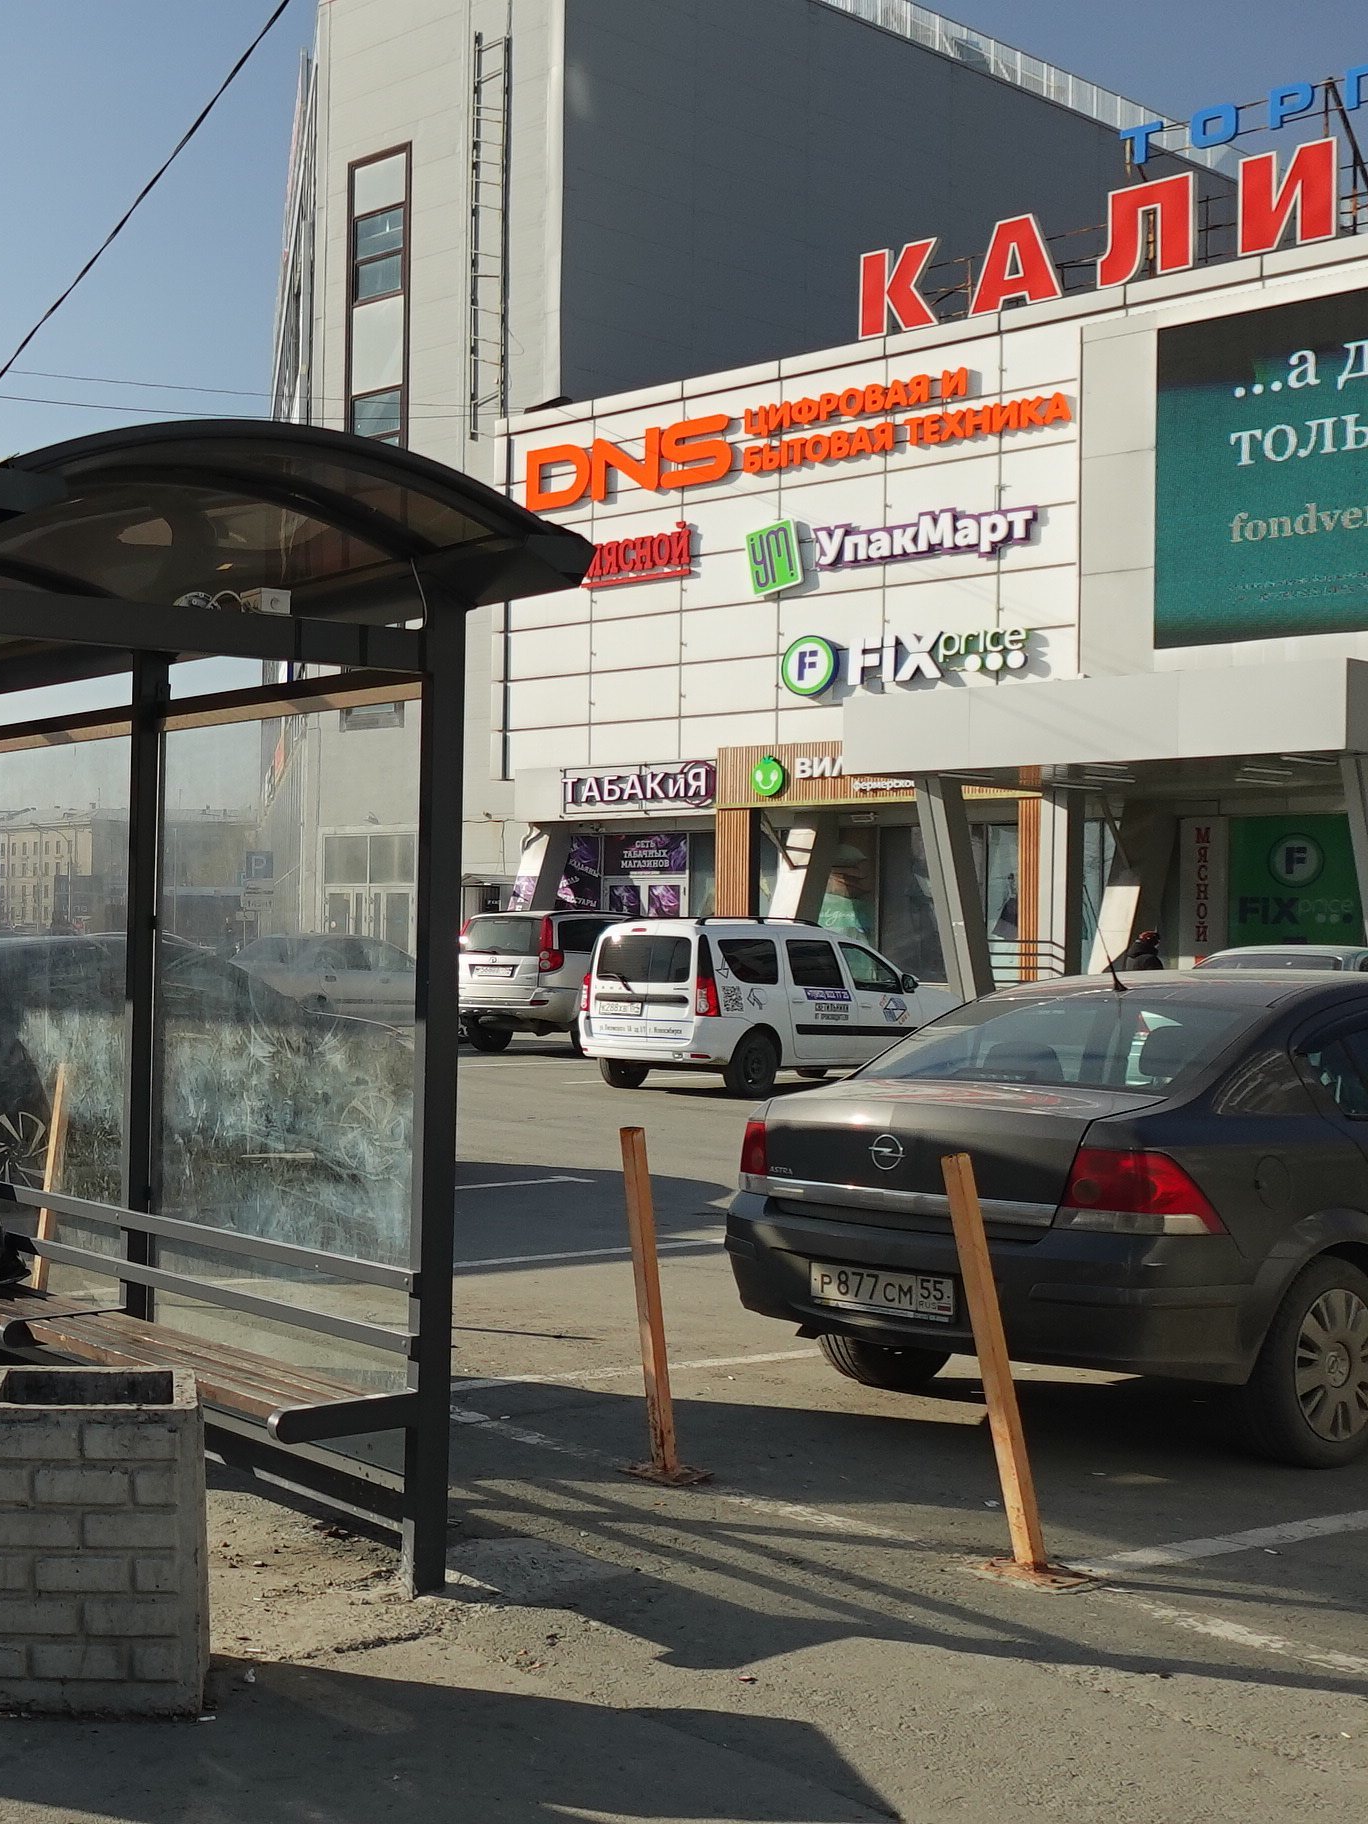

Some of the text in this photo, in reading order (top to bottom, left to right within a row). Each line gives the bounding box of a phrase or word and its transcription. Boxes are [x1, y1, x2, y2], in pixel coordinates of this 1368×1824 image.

[858, 136, 1338, 340] КАЛИ
[744, 367, 968, 437] ЦИФРОВАЯ И
[743, 392, 1072, 473] БЫТОВАЯ ТЕХНИКА
[525, 414, 732, 511] DNS
[815, 508, 1034, 568] УпакМарт
[1229, 503, 1368, 543] fondve
[621, 859, 670, 869] МАГАЗИНОВ
[623, 850, 669, 859] ТАБАЧНЫХ
[635, 840, 656, 848] СЕТЬ
[1193, 827, 1212, 942] МЯСНОЙ
[769, 1166, 793, 1175] ASTRA
[918, 1301, 937, 1309] RUS
[919, 1278, 944, 1301] 55
